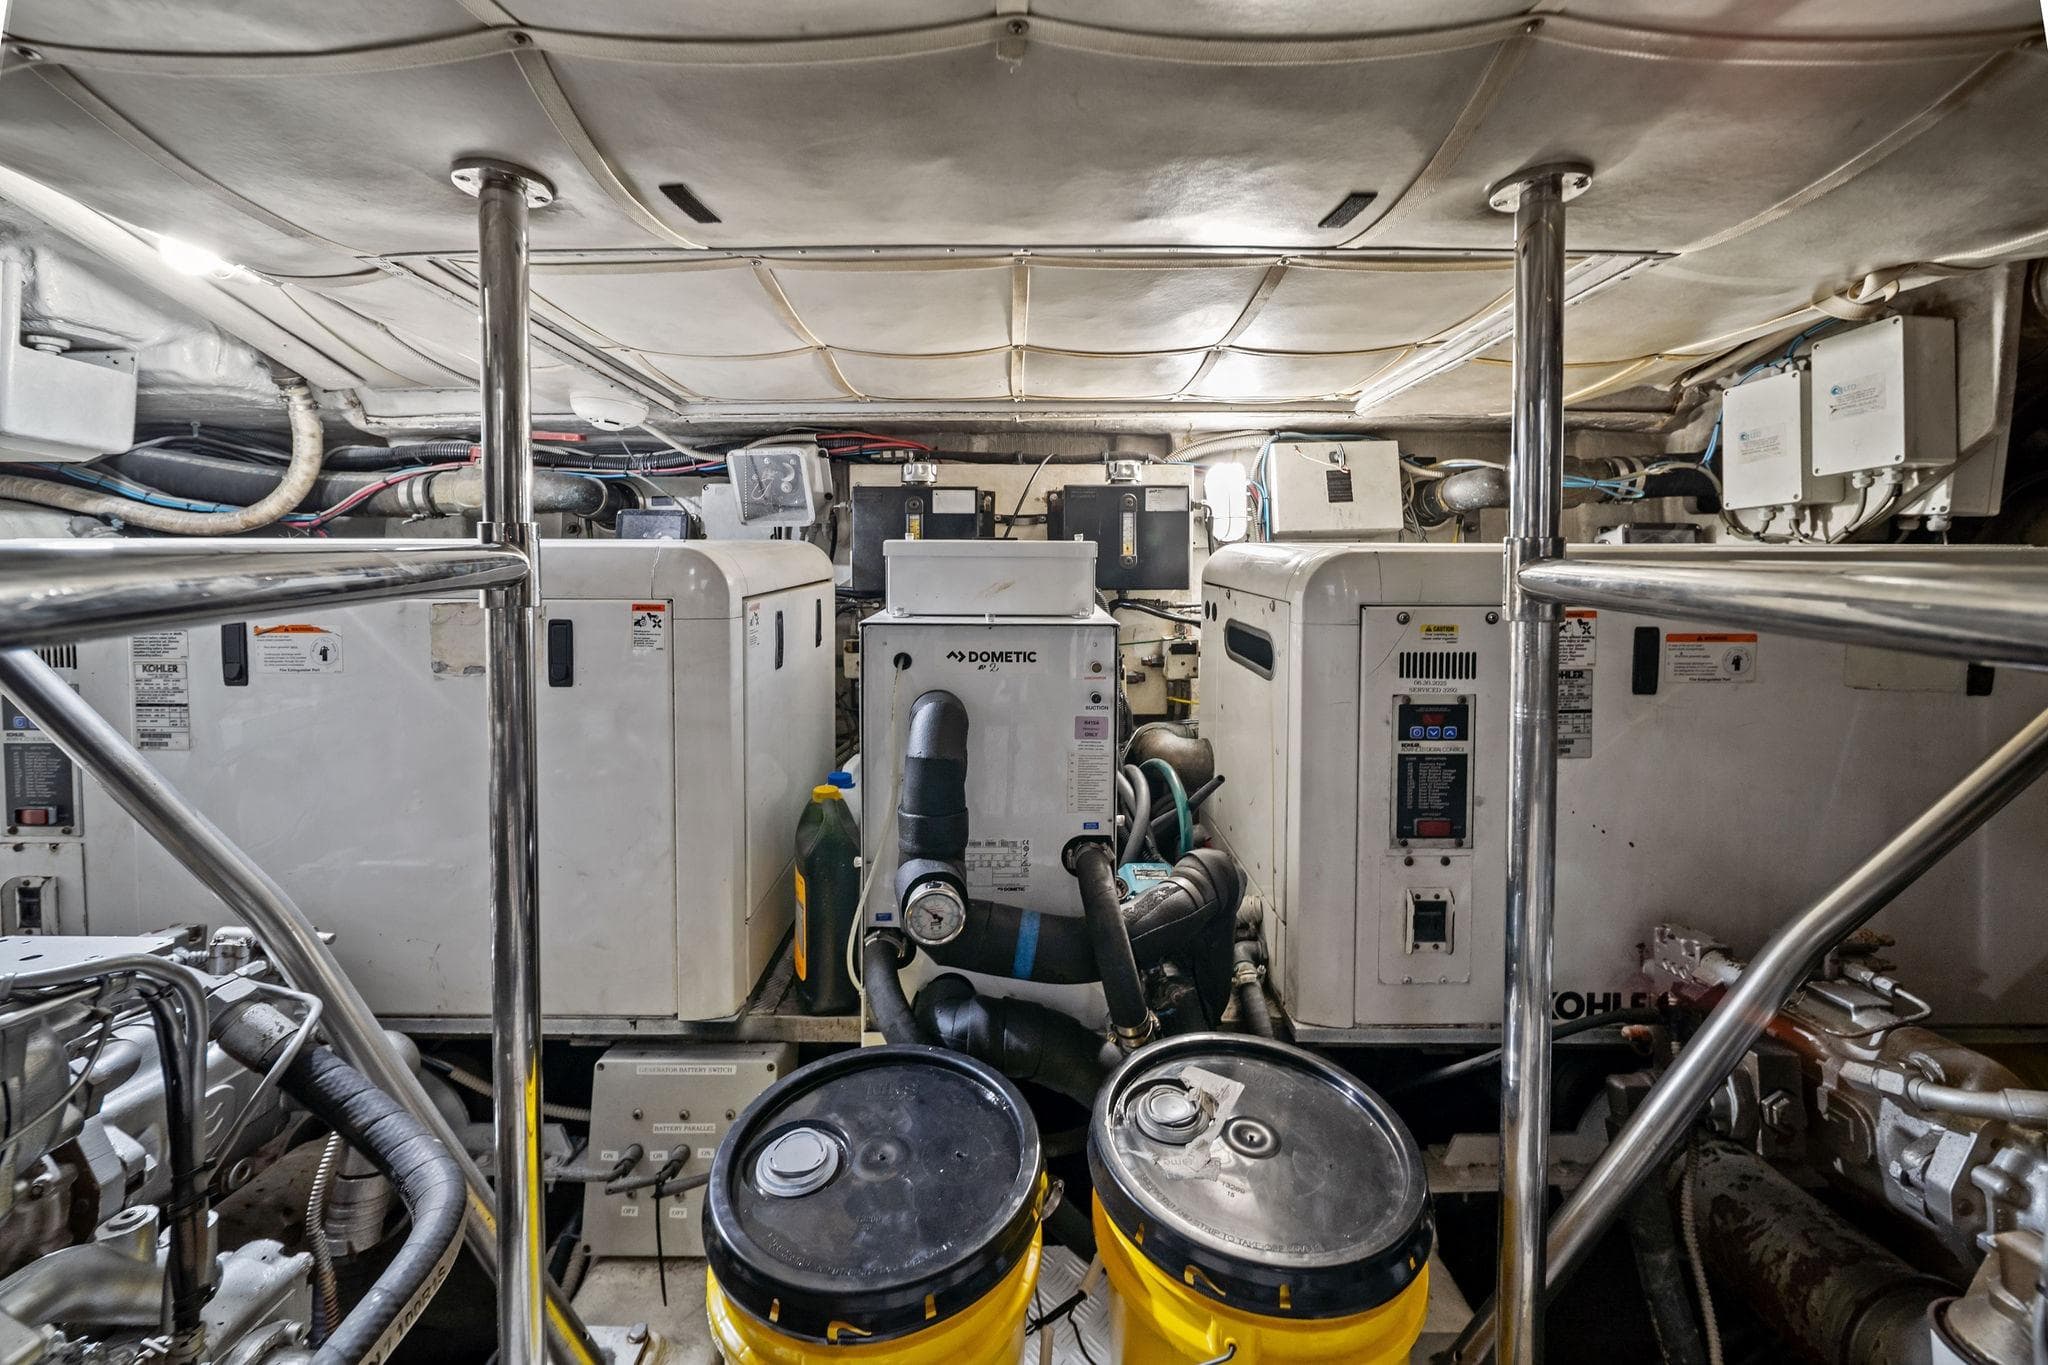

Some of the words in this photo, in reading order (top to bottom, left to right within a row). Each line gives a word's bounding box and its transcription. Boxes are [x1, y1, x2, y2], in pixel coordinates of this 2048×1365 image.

[968, 651, 1037, 663] DOMETIC
[142, 664, 178, 673] KOHLER
[1559, 670, 1584, 679] HLER
[1552, 991, 1656, 1020] OHLE
[639, 1065, 678, 1074] GENERATOR
[678, 1065, 706, 1074] BATTERY
[708, 1065, 733, 1074] SWITCH
[603, 1152, 613, 1160] ON
[652, 1152, 663, 1160] ON
[623, 1207, 637, 1215] OFF
[671, 1209, 685, 1217] OFF
